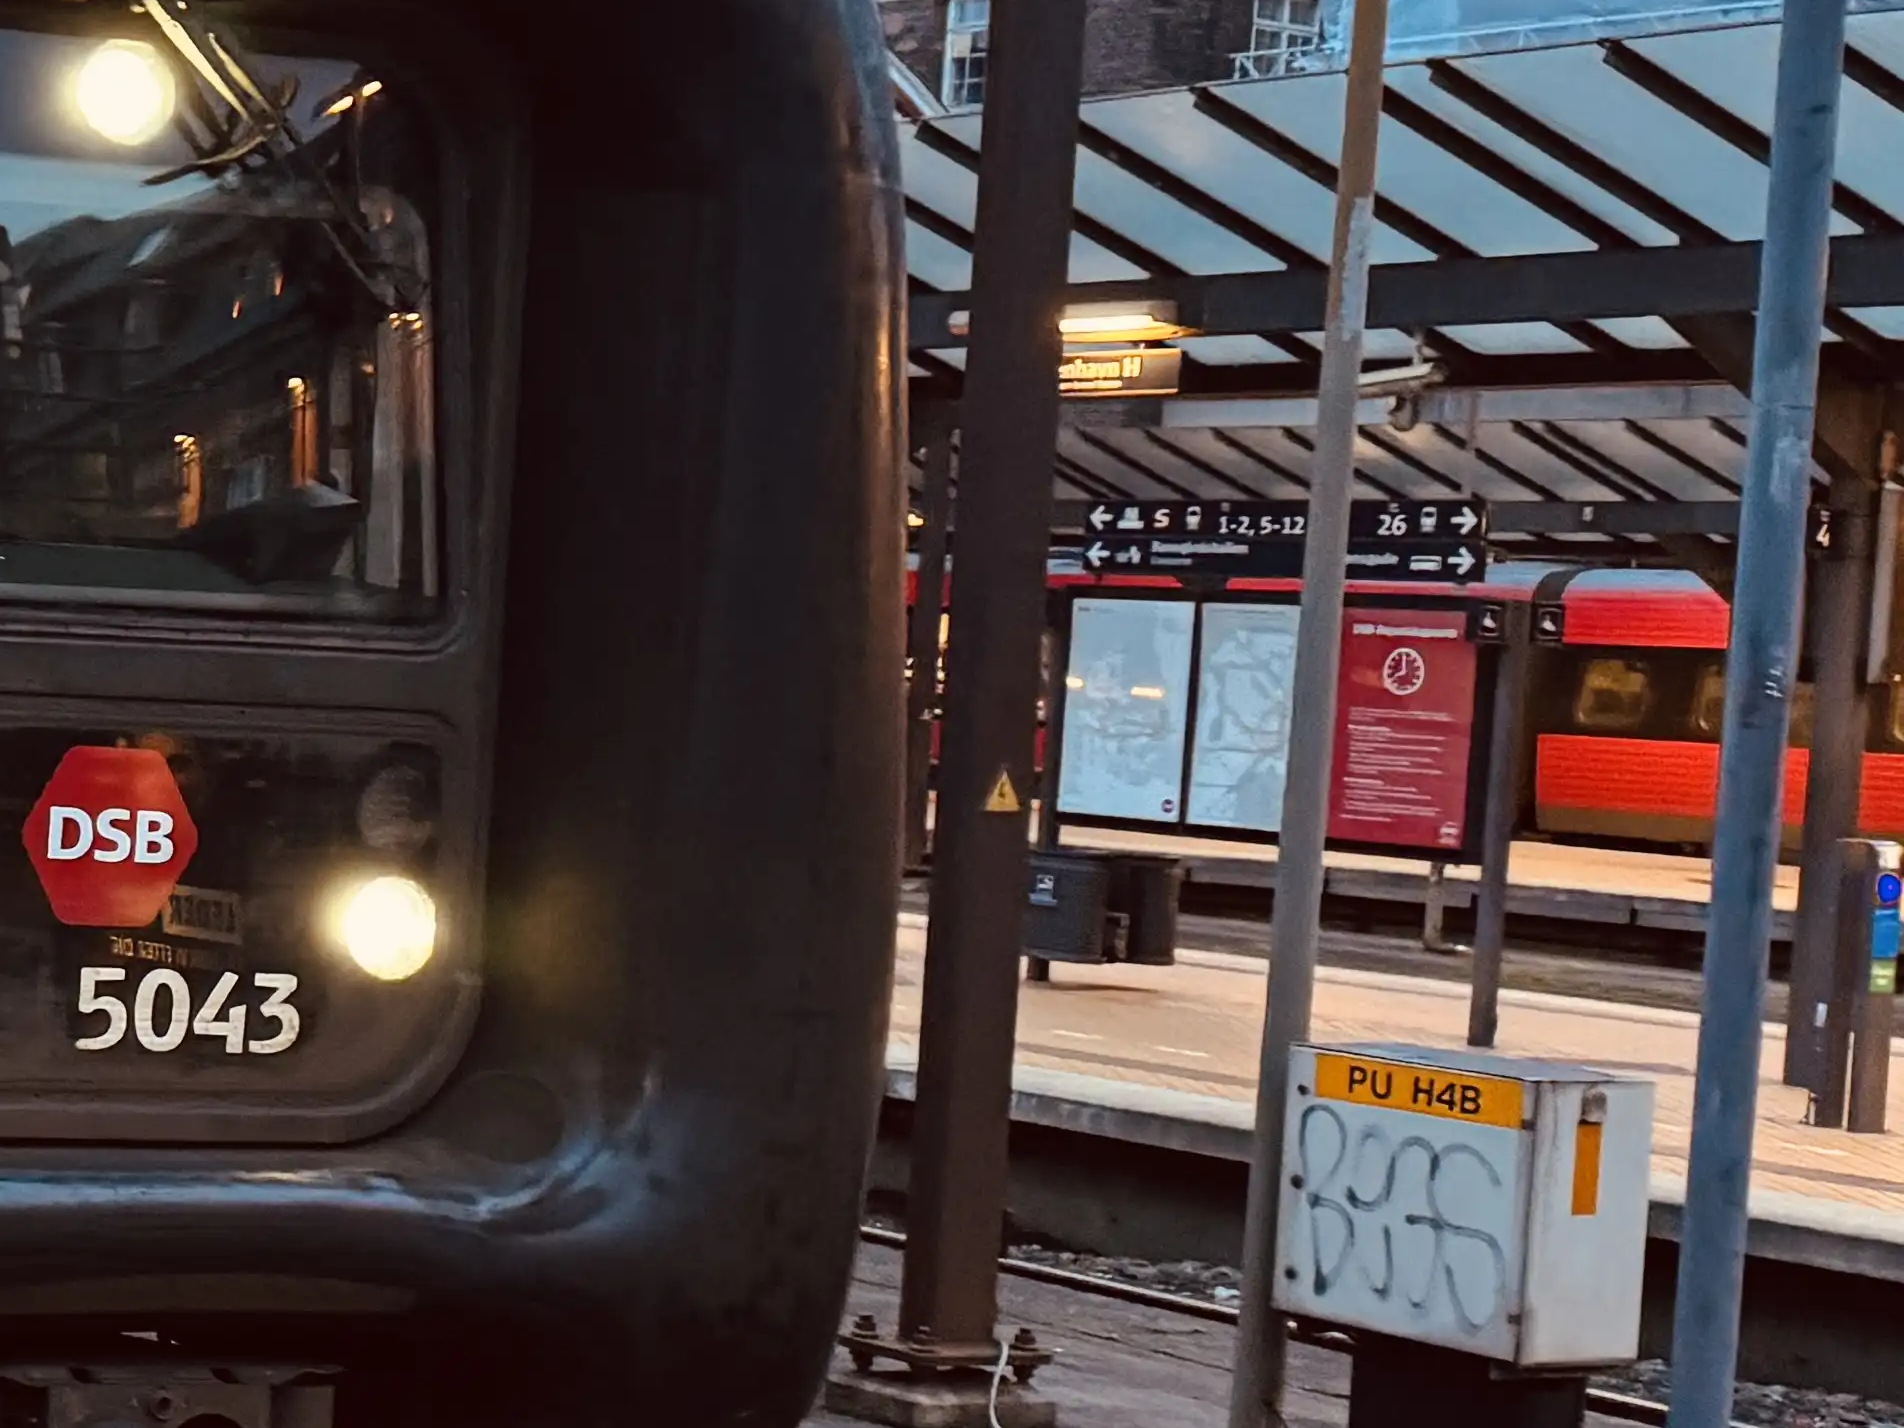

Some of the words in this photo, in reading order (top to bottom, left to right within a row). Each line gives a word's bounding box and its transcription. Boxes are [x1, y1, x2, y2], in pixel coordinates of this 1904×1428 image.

[1218, 515, 1256, 537] 1-2,
[1259, 515, 1306, 535] 5-12
[1376, 513, 1408, 536] 26
[1815, 523, 1830, 547] 4
[46, 805, 175, 864] DSB
[75, 966, 301, 1054] 5043
[1347, 1064, 1392, 1100] PU
[1411, 1075, 1482, 1115] H4B
